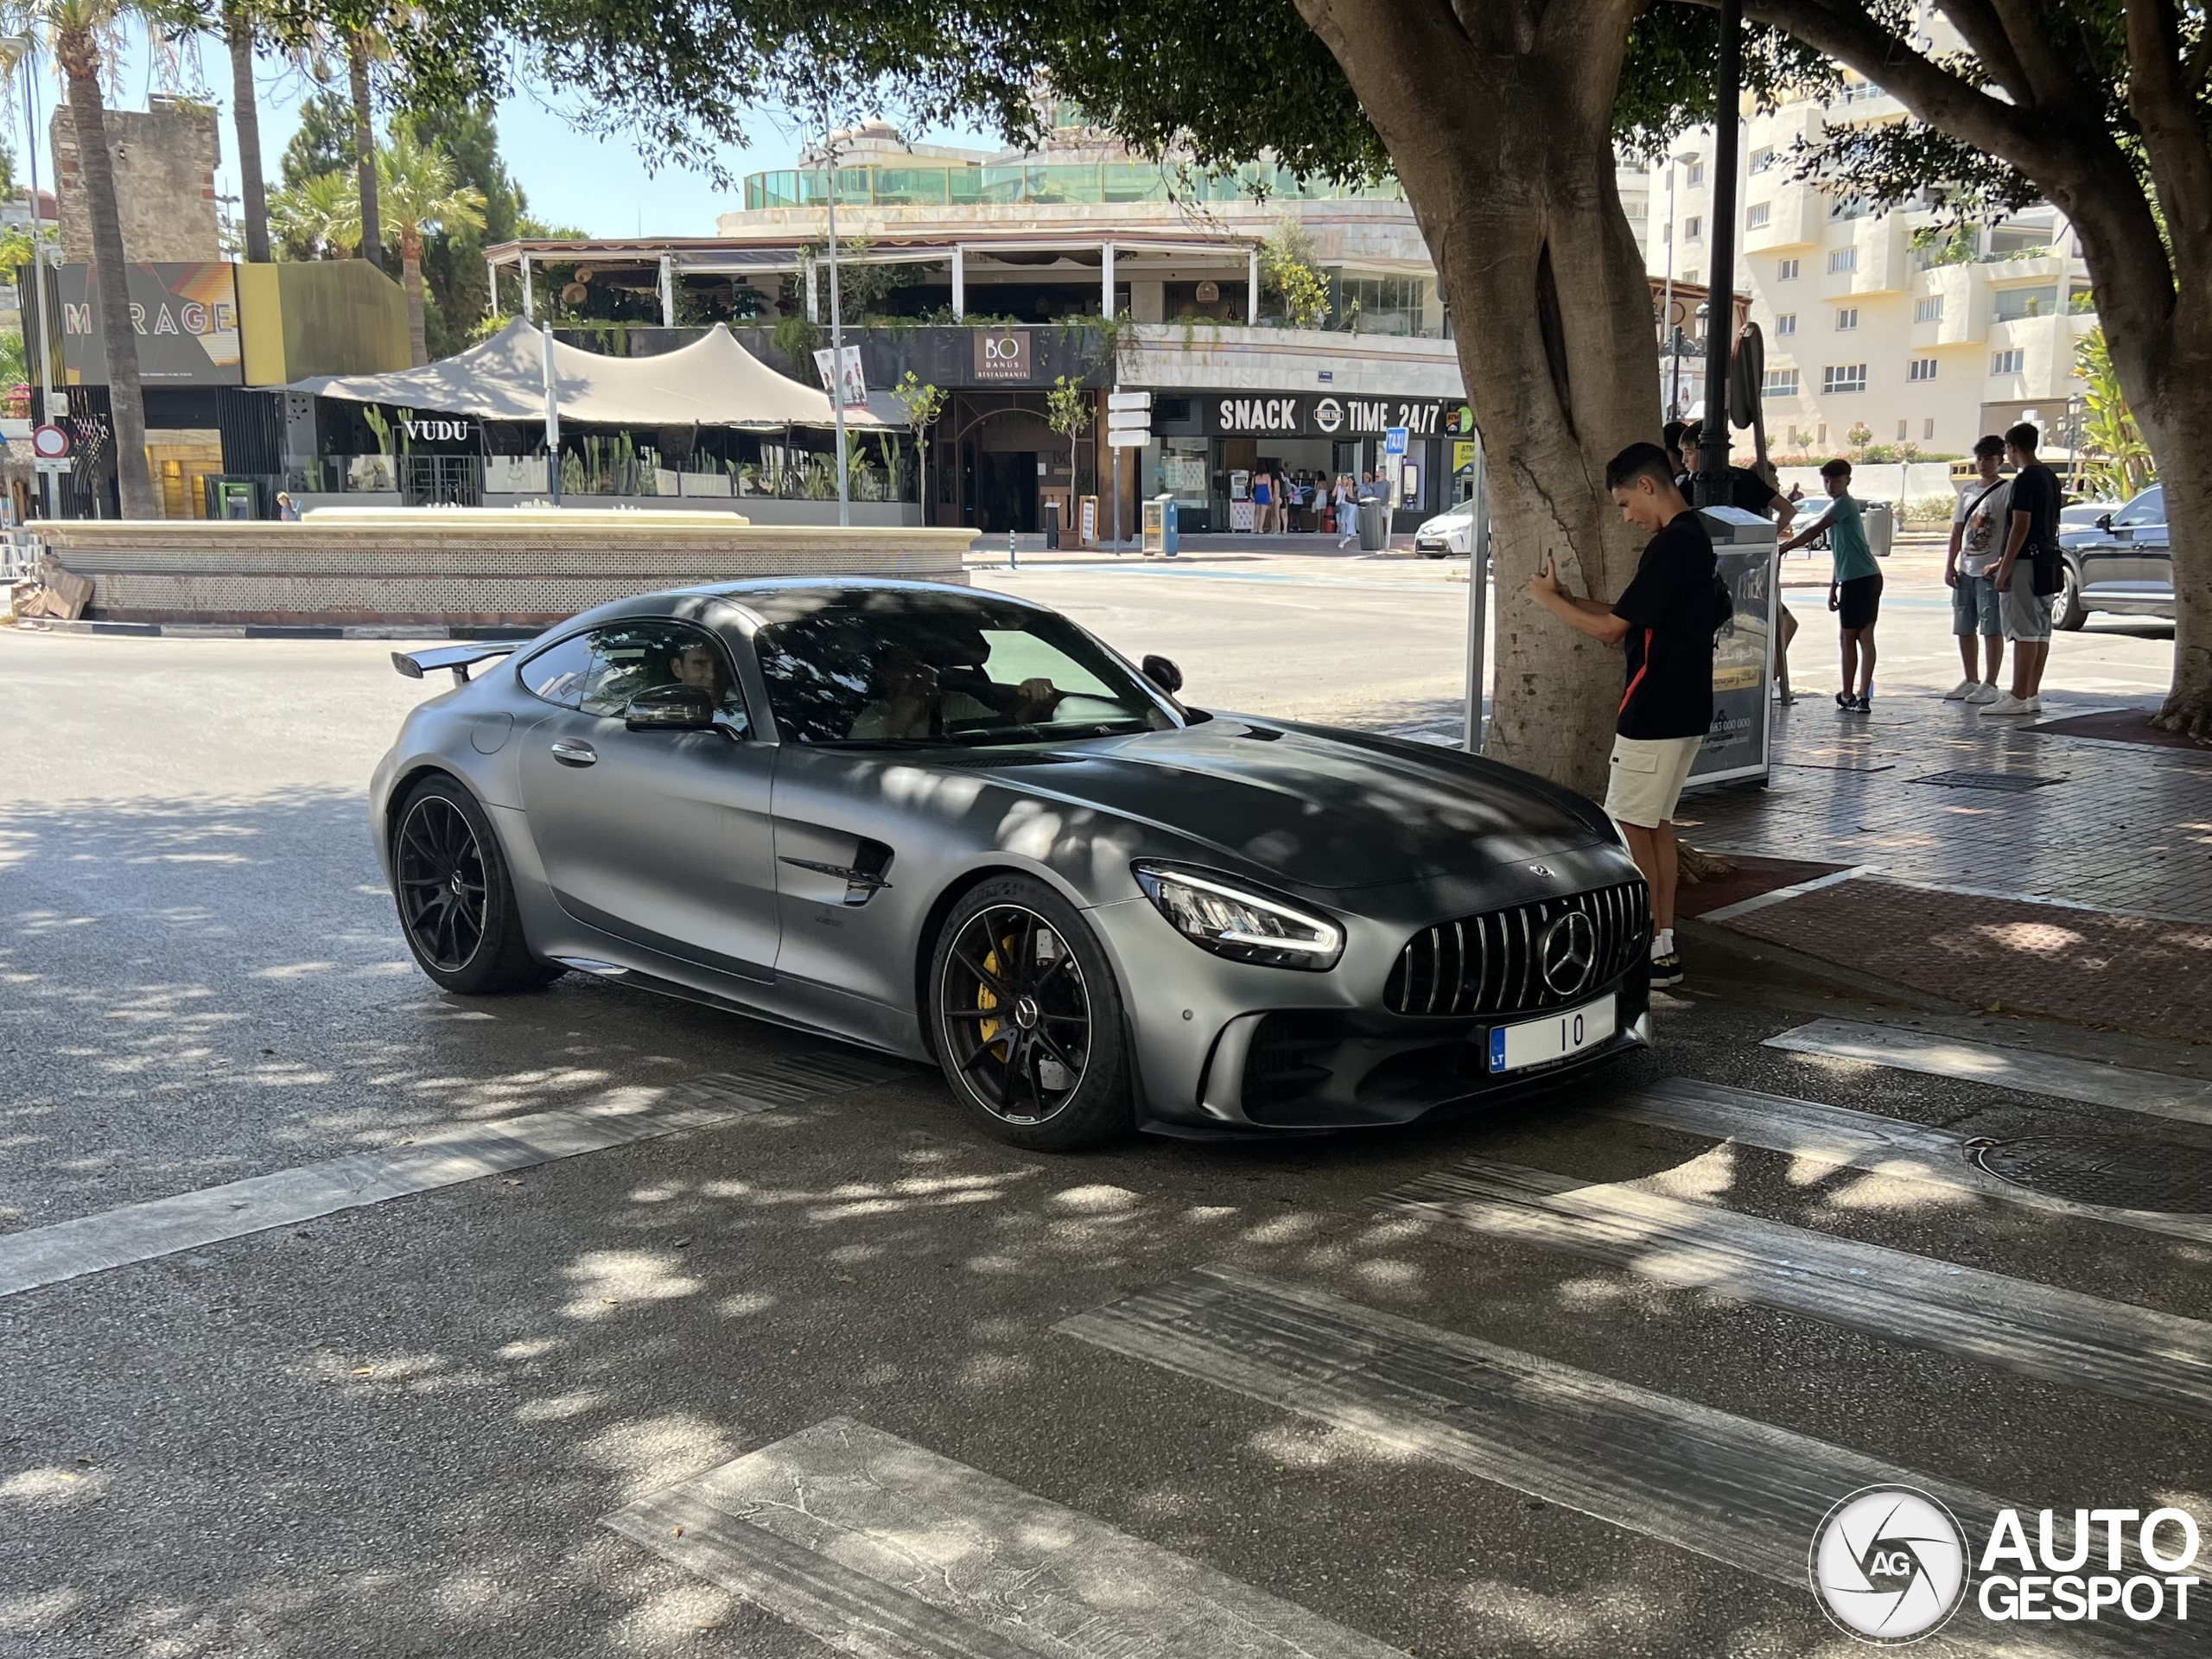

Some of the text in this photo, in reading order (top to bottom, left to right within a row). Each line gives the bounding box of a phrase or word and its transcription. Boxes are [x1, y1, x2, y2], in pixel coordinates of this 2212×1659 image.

[64, 302, 233, 335] MRAGE
[985, 338, 1019, 359] BO
[1220, 399, 1296, 430] SNACK
[1348, 401, 1389, 432] TIME
[1399, 404, 1440, 434] 24/7
[404, 420, 468, 441] VUDU
[1388, 433, 1405, 450] TAXI
[1723, 720, 1737, 731] 000
[1737, 717, 1751, 728] 000
[1491, 1054, 1504, 1065] LT
